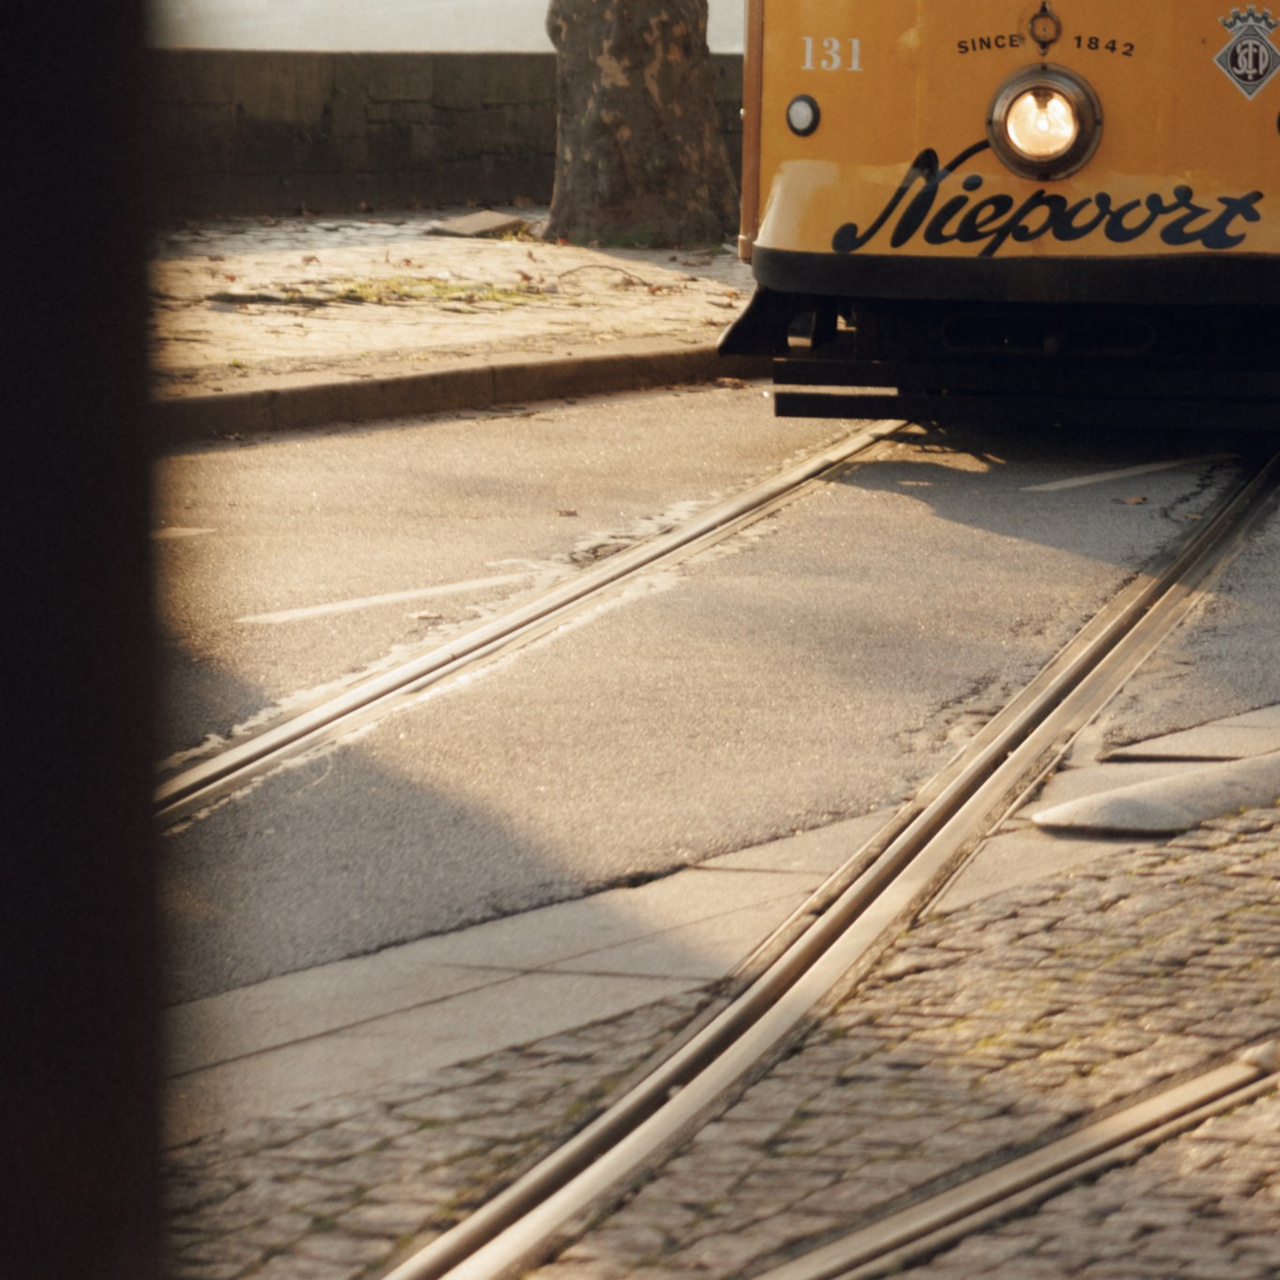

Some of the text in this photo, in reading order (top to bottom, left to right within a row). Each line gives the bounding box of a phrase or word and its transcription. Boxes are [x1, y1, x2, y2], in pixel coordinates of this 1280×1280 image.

[800, 36, 863, 72] 131
[957, 34, 1135, 57] SINCE 1842
[831, 139, 1265, 258] Niepoort
